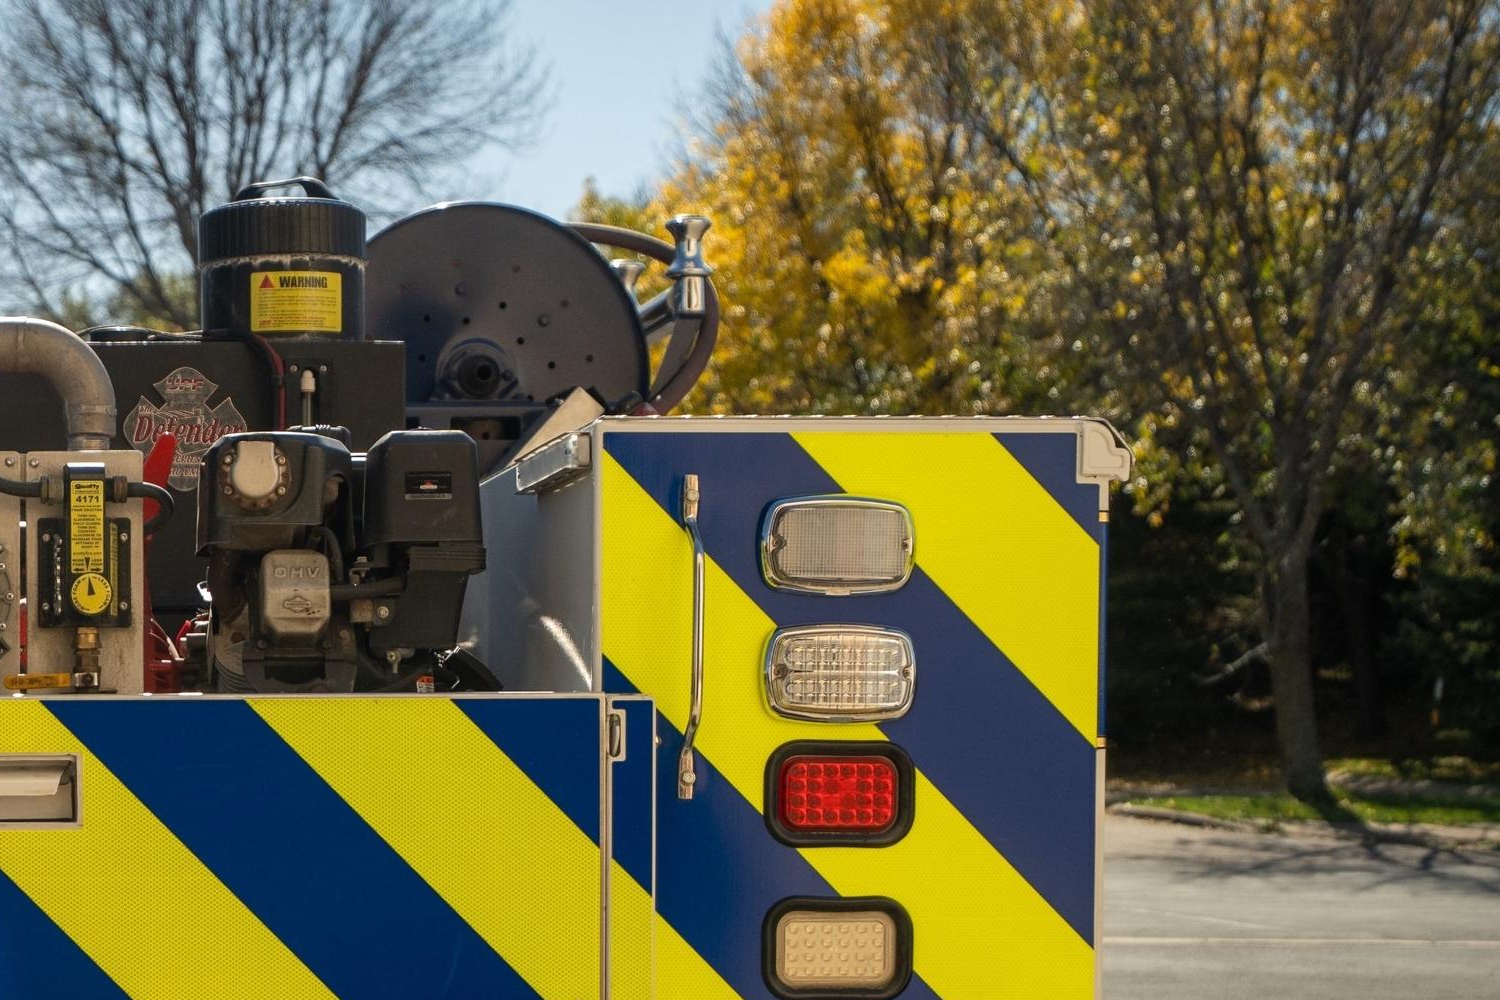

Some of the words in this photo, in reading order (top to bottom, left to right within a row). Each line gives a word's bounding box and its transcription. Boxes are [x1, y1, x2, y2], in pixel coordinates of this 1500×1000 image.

[279, 276, 328, 289] WARNING
[76, 495, 99, 503] 4171
[274, 567, 320, 578] OHV
